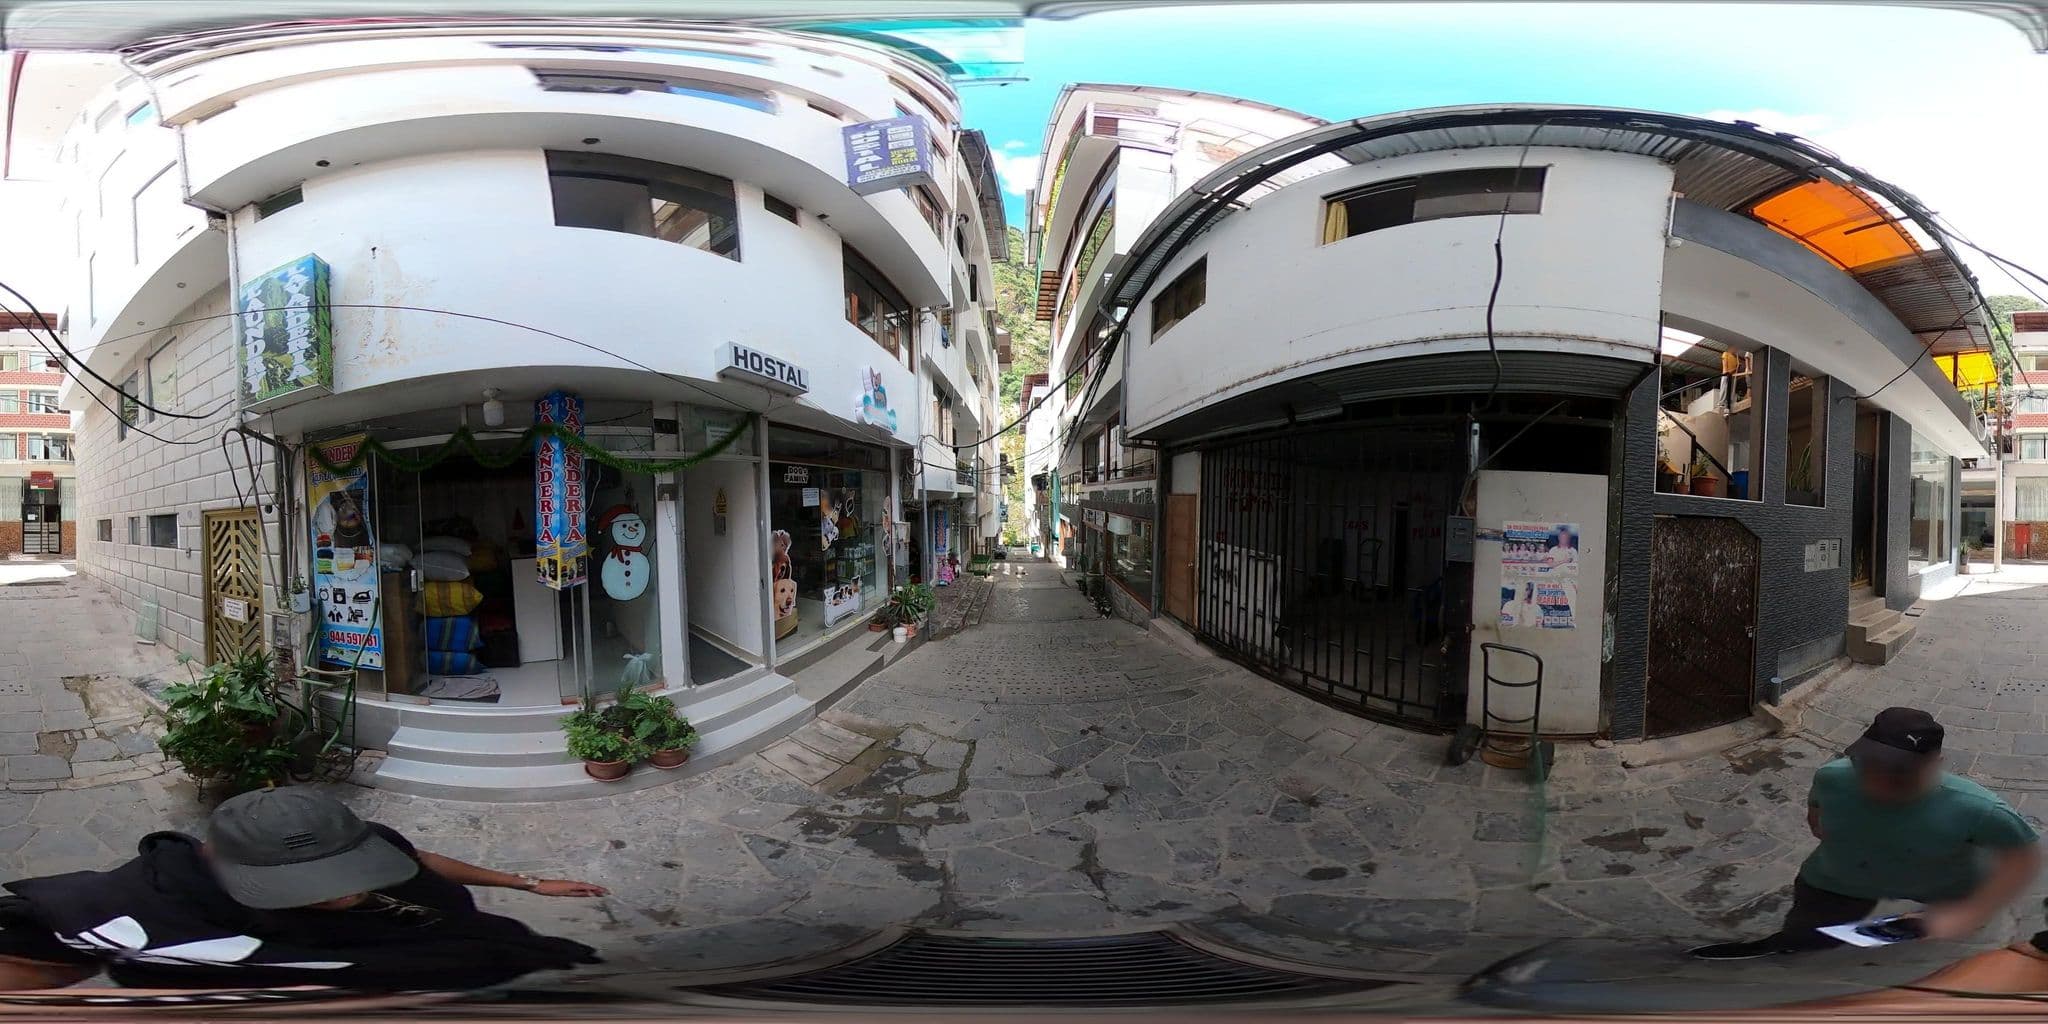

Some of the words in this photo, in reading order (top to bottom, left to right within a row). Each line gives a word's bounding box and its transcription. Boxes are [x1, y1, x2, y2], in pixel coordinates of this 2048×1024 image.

[849, 130, 883, 172] HOSTAL
[244, 287, 267, 394] LAUNDRY
[733, 346, 808, 388] HOSTAL
[539, 400, 556, 543] LAANDERIA
[784, 473, 809, 484] FAMILY
[329, 630, 346, 644] 944
